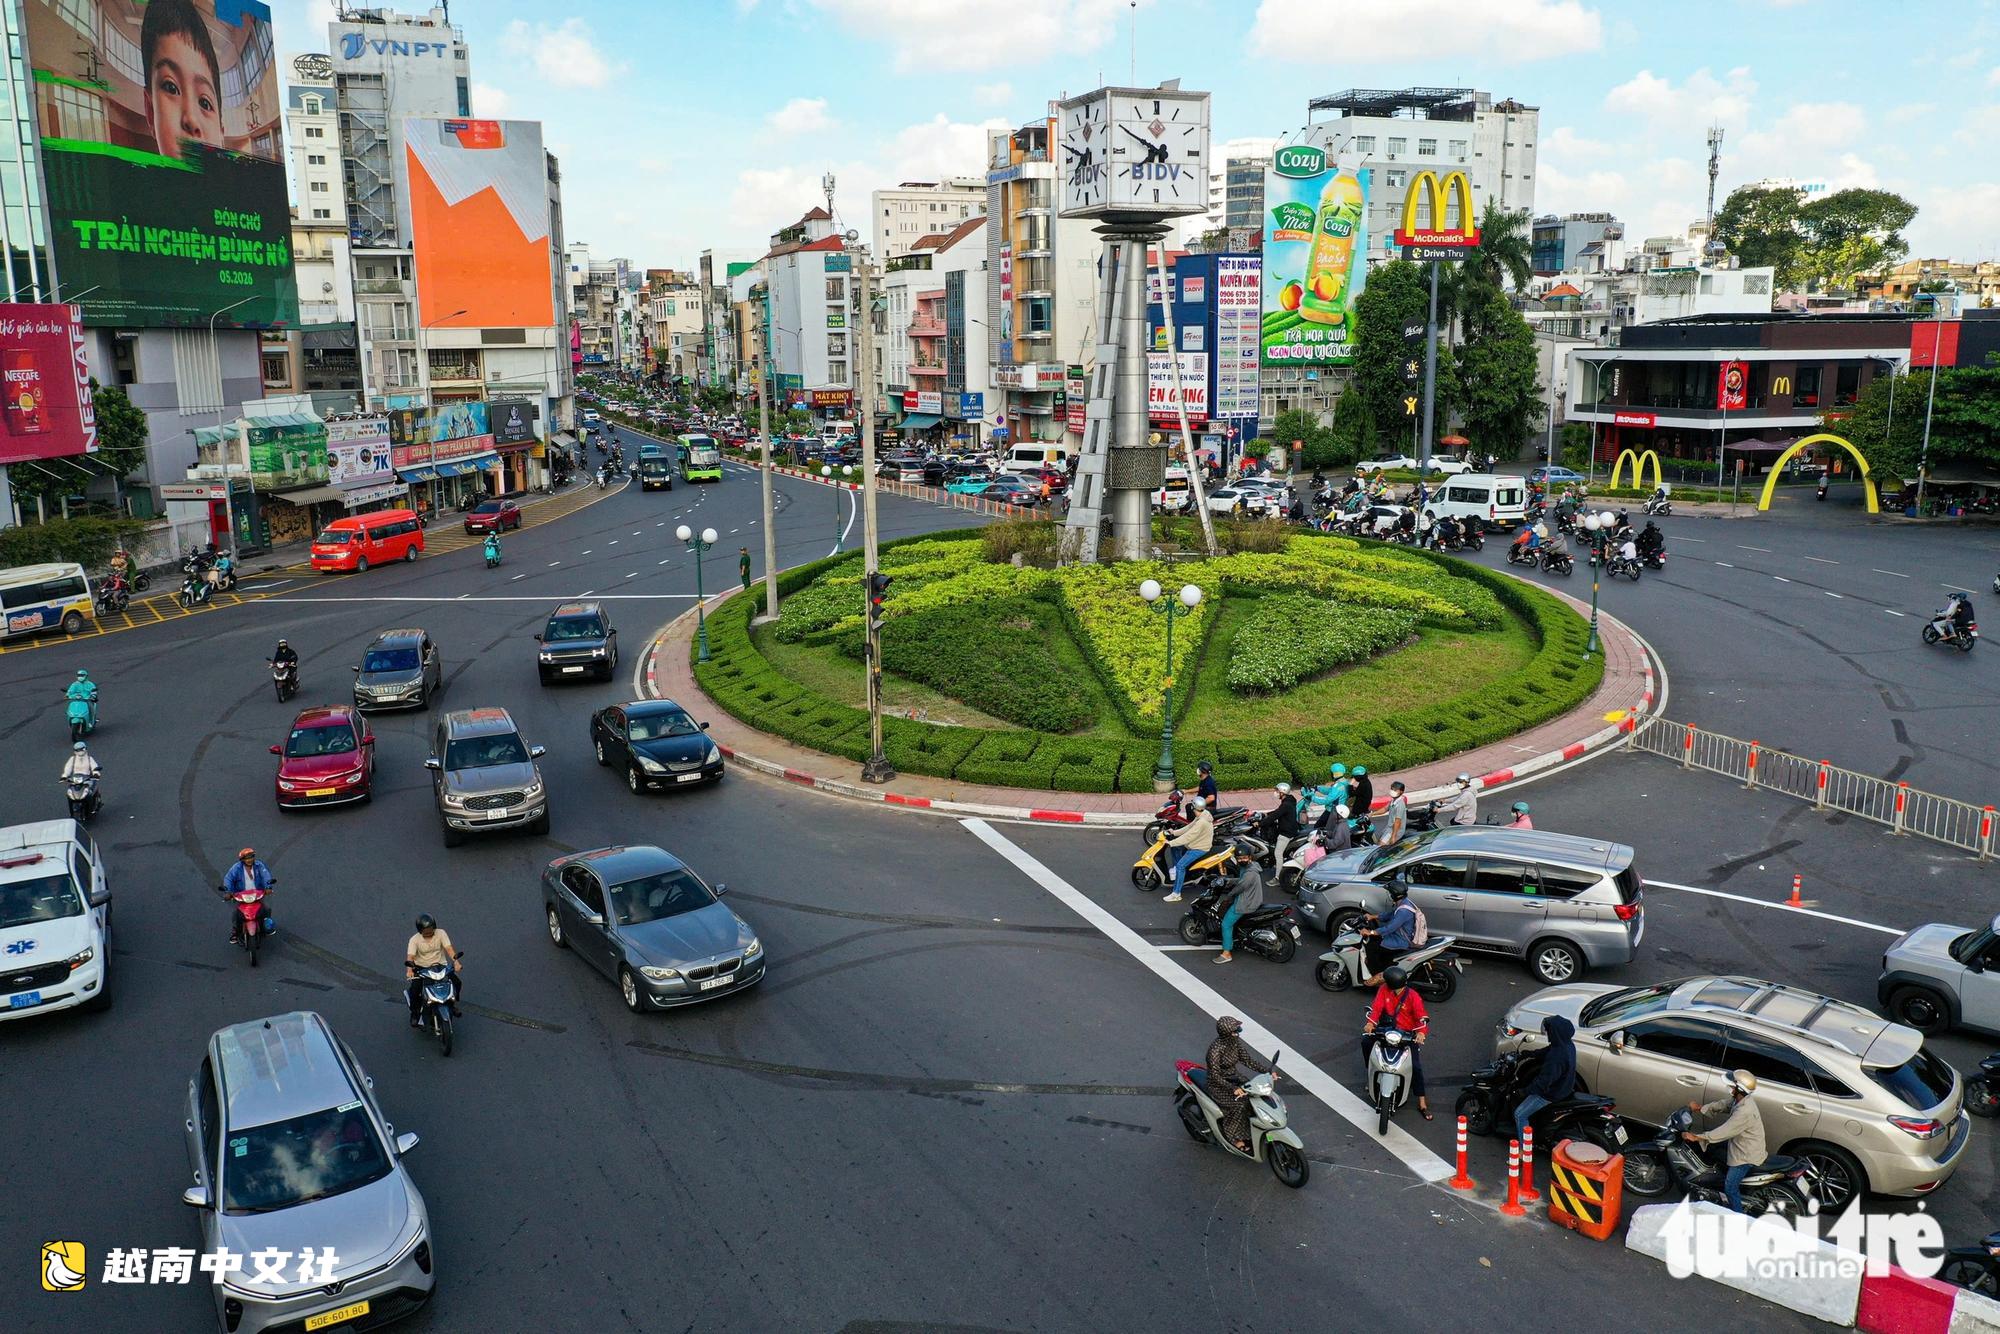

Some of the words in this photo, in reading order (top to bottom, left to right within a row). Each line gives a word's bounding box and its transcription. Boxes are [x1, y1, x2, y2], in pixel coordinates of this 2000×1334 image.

[370, 39, 448, 58] VNPT
[1280, 151, 1321, 172] Cozy
[1074, 164, 1101, 186] BIDV
[1131, 162, 1180, 181] BIDV
[214, 207, 238, 226] ĐÓN
[239, 209, 263, 231] CHỜ
[1283, 216, 1310, 230] Mới
[1325, 219, 1350, 235] Cozy
[72, 215, 141, 252] TRẢI
[144, 226, 217, 264] NGHIỆM
[219, 231, 264, 266] BÙNG
[265, 236, 289, 267] NỔ
[1413, 234, 1464, 243] McDonald's
[1423, 249, 1445, 257] Drive
[1447, 249, 1464, 257] Thru
[219, 270, 254, 286] 05.2026
[1305, 329, 1323, 342] HOA
[1241, 349, 1254, 357] LS
[373, 454, 389, 471] 7K
